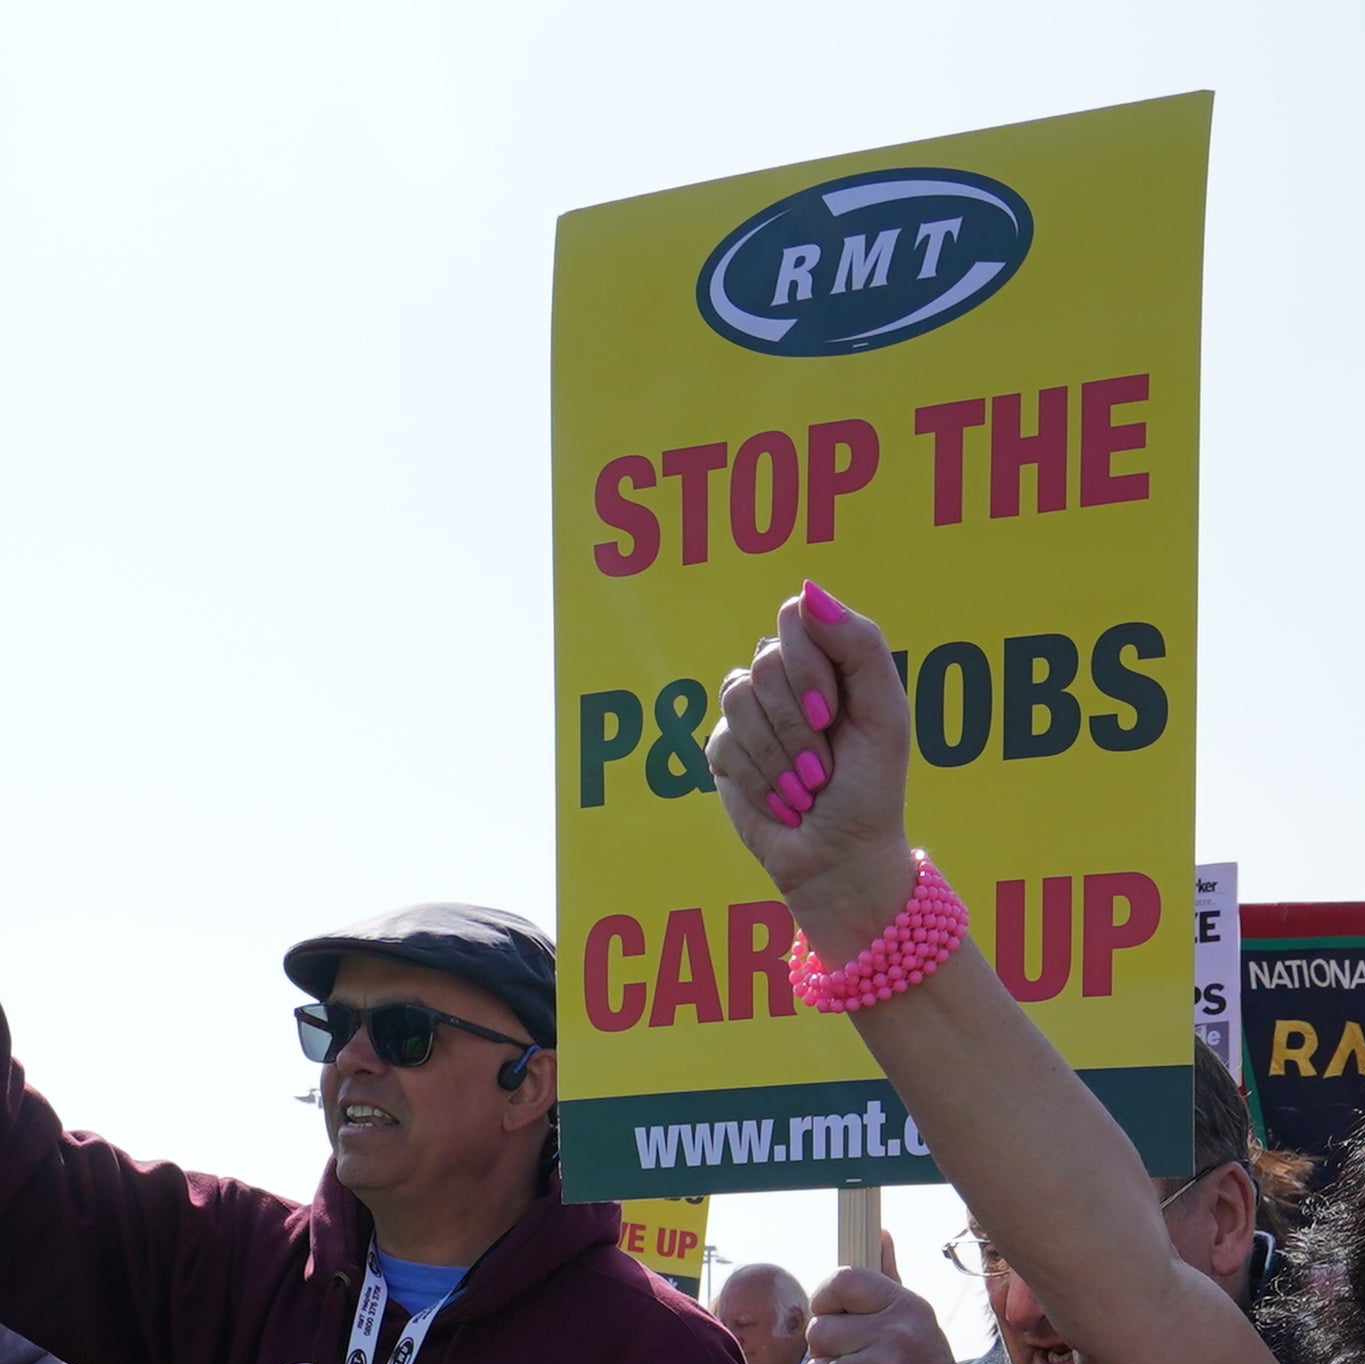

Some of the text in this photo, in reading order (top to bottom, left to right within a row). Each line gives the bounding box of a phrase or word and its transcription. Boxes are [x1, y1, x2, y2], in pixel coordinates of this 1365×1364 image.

[769, 215, 964, 307] RMT
[593, 372, 1151, 578] STOP THE
[579, 621, 1170, 809] P& OBS
[583, 871, 1163, 1033] CAR UP
[656, 1226, 698, 1259] UP
